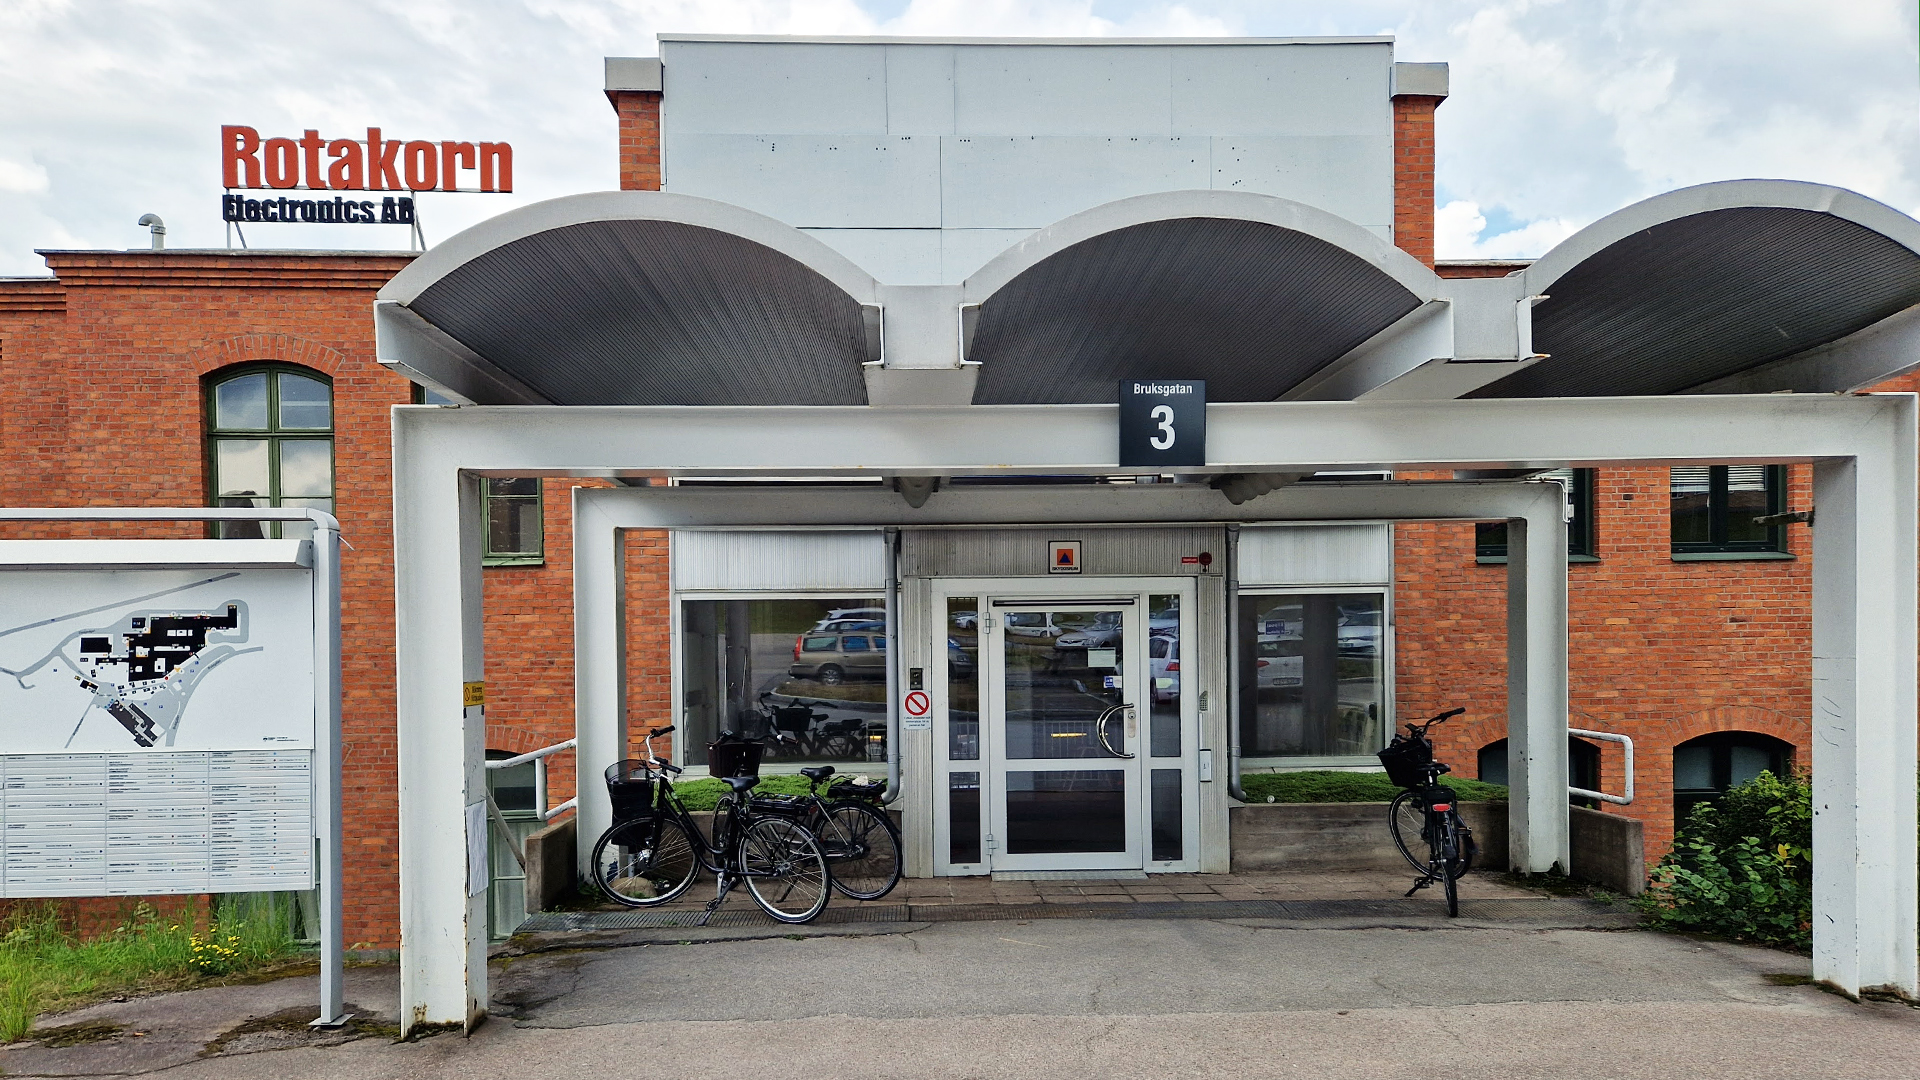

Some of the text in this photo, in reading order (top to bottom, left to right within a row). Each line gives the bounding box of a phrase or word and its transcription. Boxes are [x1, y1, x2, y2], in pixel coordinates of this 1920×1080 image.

[221, 124, 513, 193] Rotakorn
[222, 194, 414, 224] Electronics AB
[1133, 383, 1192, 396] Bruksgatan
[1150, 405, 1176, 450] 3
